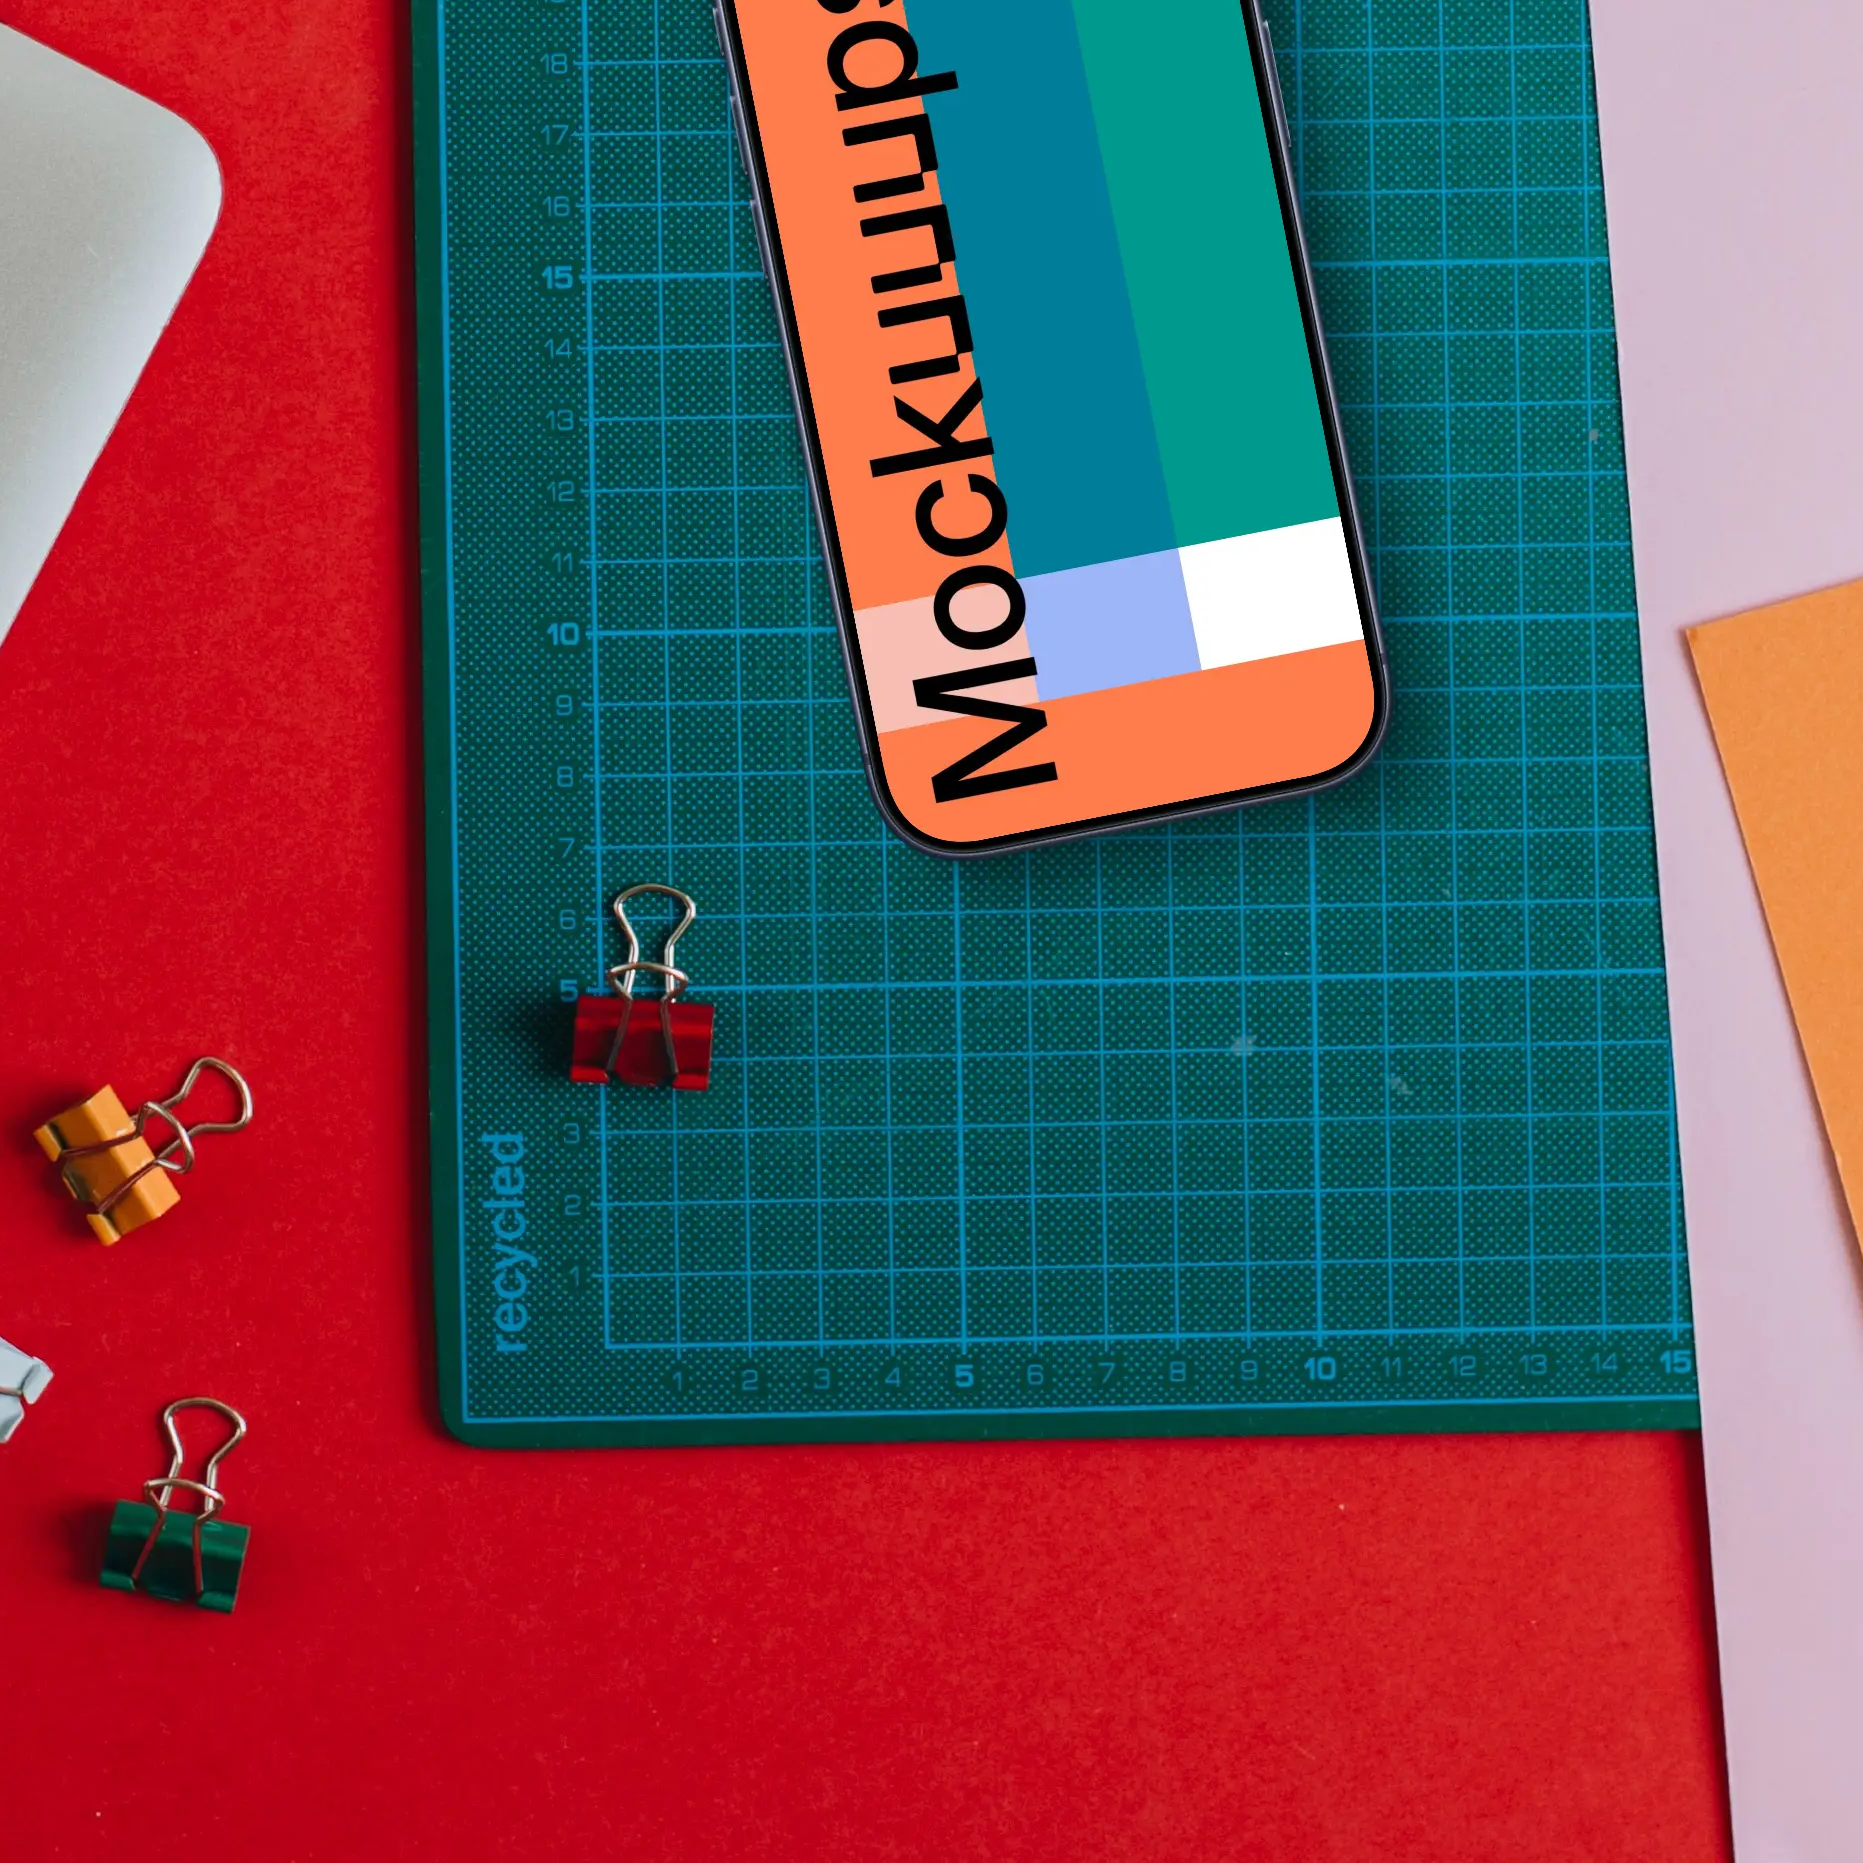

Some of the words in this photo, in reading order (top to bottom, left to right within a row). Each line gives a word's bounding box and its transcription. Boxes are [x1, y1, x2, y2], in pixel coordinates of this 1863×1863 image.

[539, 53, 568, 74] 18
[540, 125, 569, 145] 17
[542, 196, 571, 217] 16
[542, 266, 573, 290] 15
[544, 339, 573, 359] 14
[545, 410, 574, 431] 13
[547, 481, 575, 502] 12
[551, 553, 573, 574] 11
[547, 622, 580, 646] 10
[555, 695, 572, 716] 9
[556, 766, 574, 788] 8
[558, 838, 575, 858] 7
[559, 909, 576, 931] 6
[560, 979, 578, 1002] 5
[563, 1123, 580, 1144] 3
[564, 1195, 582, 1216] 2
[481, 1133, 537, 1352] recycled
[569, 1266, 580, 1286] 1
[1168, 1361, 1186, 1382] 8
[1240, 1359, 1259, 1381] 9
[1304, 1357, 1336, 1381] 10
[1380, 1357, 1402, 1378] 11
[1447, 1355, 1477, 1377] 12
[1518, 1354, 1548, 1375] 13
[1590, 1353, 1619, 1374] 14
[1660, 1350, 1692, 1374] 15
[672, 1371, 683, 1391] 1
[741, 1370, 759, 1391] 2
[814, 1368, 831, 1389] 3
[884, 1367, 902, 1388] 4
[955, 1364, 974, 1387] 5
[1026, 1363, 1044, 1385] 6
[1097, 1362, 1116, 1384] 7
